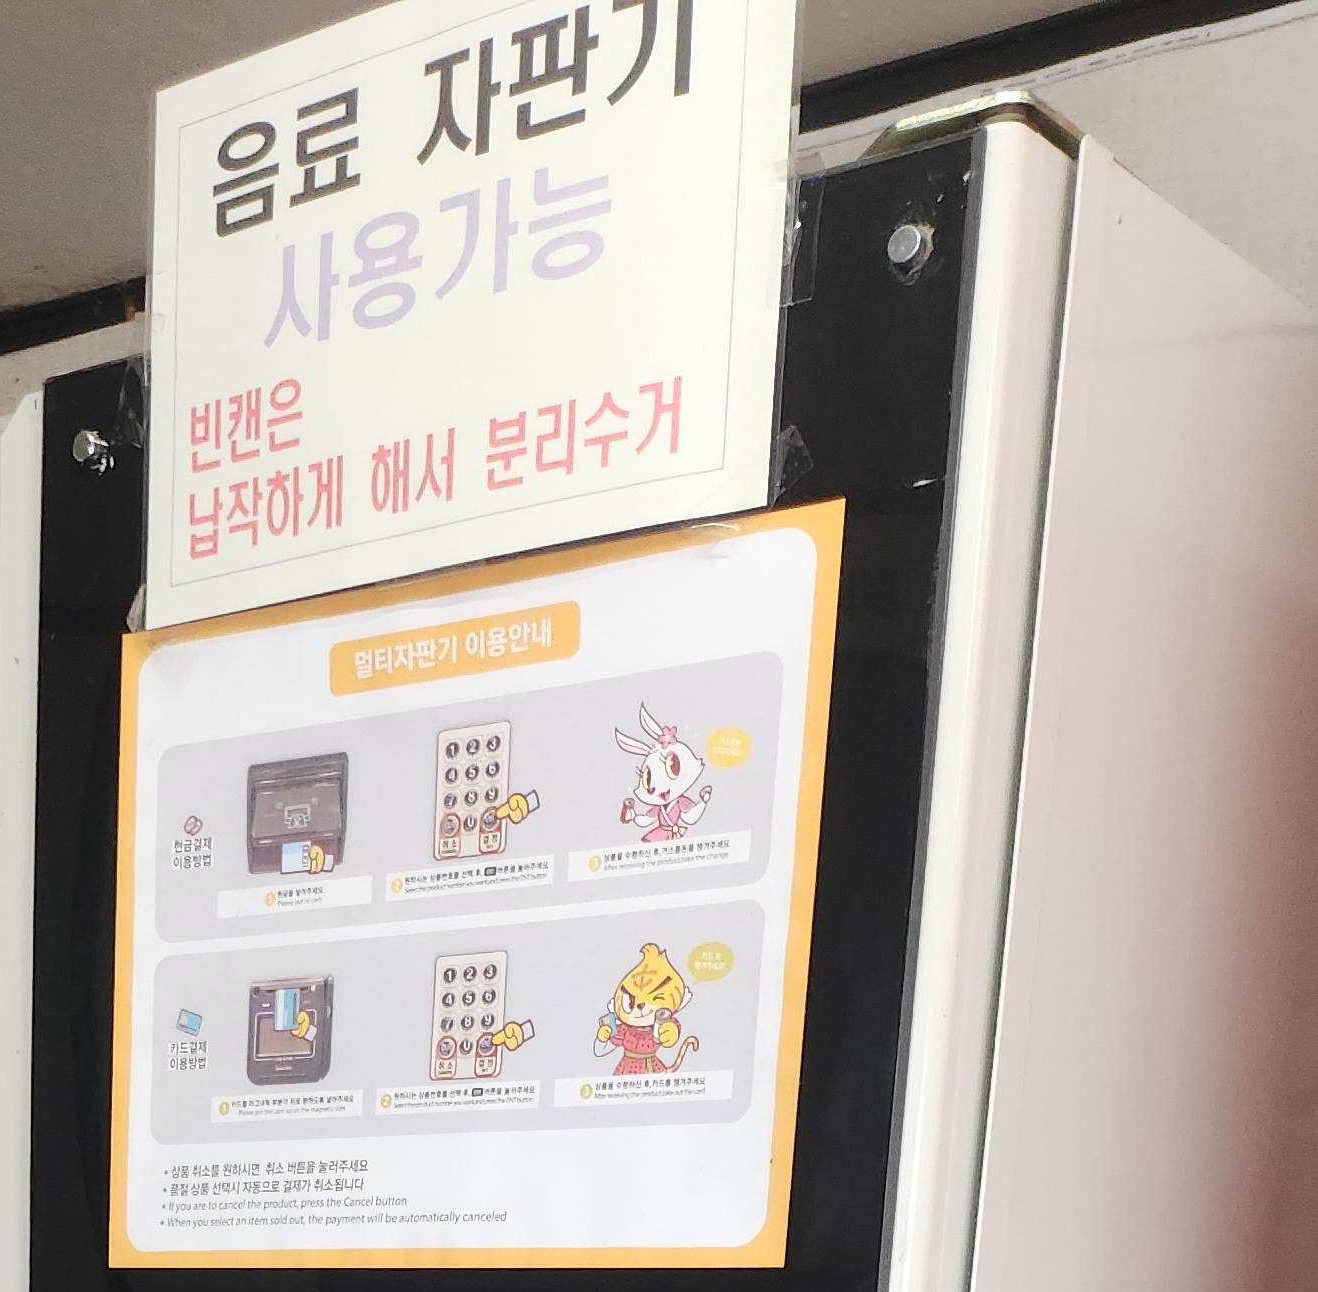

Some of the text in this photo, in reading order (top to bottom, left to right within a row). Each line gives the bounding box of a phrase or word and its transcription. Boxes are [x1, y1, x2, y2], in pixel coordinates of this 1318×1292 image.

[213, 0, 694, 237] 음료 자판기
[264, 166, 612, 348] 사용가능
[190, 377, 303, 473] 빈캔은
[189, 375, 683, 560] 납작하게 해서 분리수거
[354, 617, 552, 679] 멀티자판기 이용안내
[173, 837, 213, 853] 현금결제
[173, 854, 213, 869] 이용방법
[170, 1041, 207, 1055] 카드결제
[170, 1057, 207, 1071] 이용방법
[171, 1159, 368, 1179] 상품 취소를 원하시면 취소 버튼을 눌러주세요
[191, 1182, 209, 1196] 상품
[212, 1181, 240, 1195] 선택시
[242, 1179, 280, 1194] 자동으로
[283, 1178, 311, 1192] 결제가
[314, 1177, 365, 1192] 취소됩니다
[176, 1203, 191, 1214] you
[193, 1203, 206, 1211] are
[208, 1201, 217, 1210] to
[219, 1199, 245, 1210] cancel
[247, 1199, 261, 1209] the
[263, 1198, 297, 1211] product,
[301, 1199, 324, 1210] press
[327, 1198, 341, 1207] the
[344, 1197, 373, 1207] Cancel
[376, 1196, 407, 1206] button
[167, 1211, 508, 1229] When you select an item sold out, the payment will be automatically canceled
